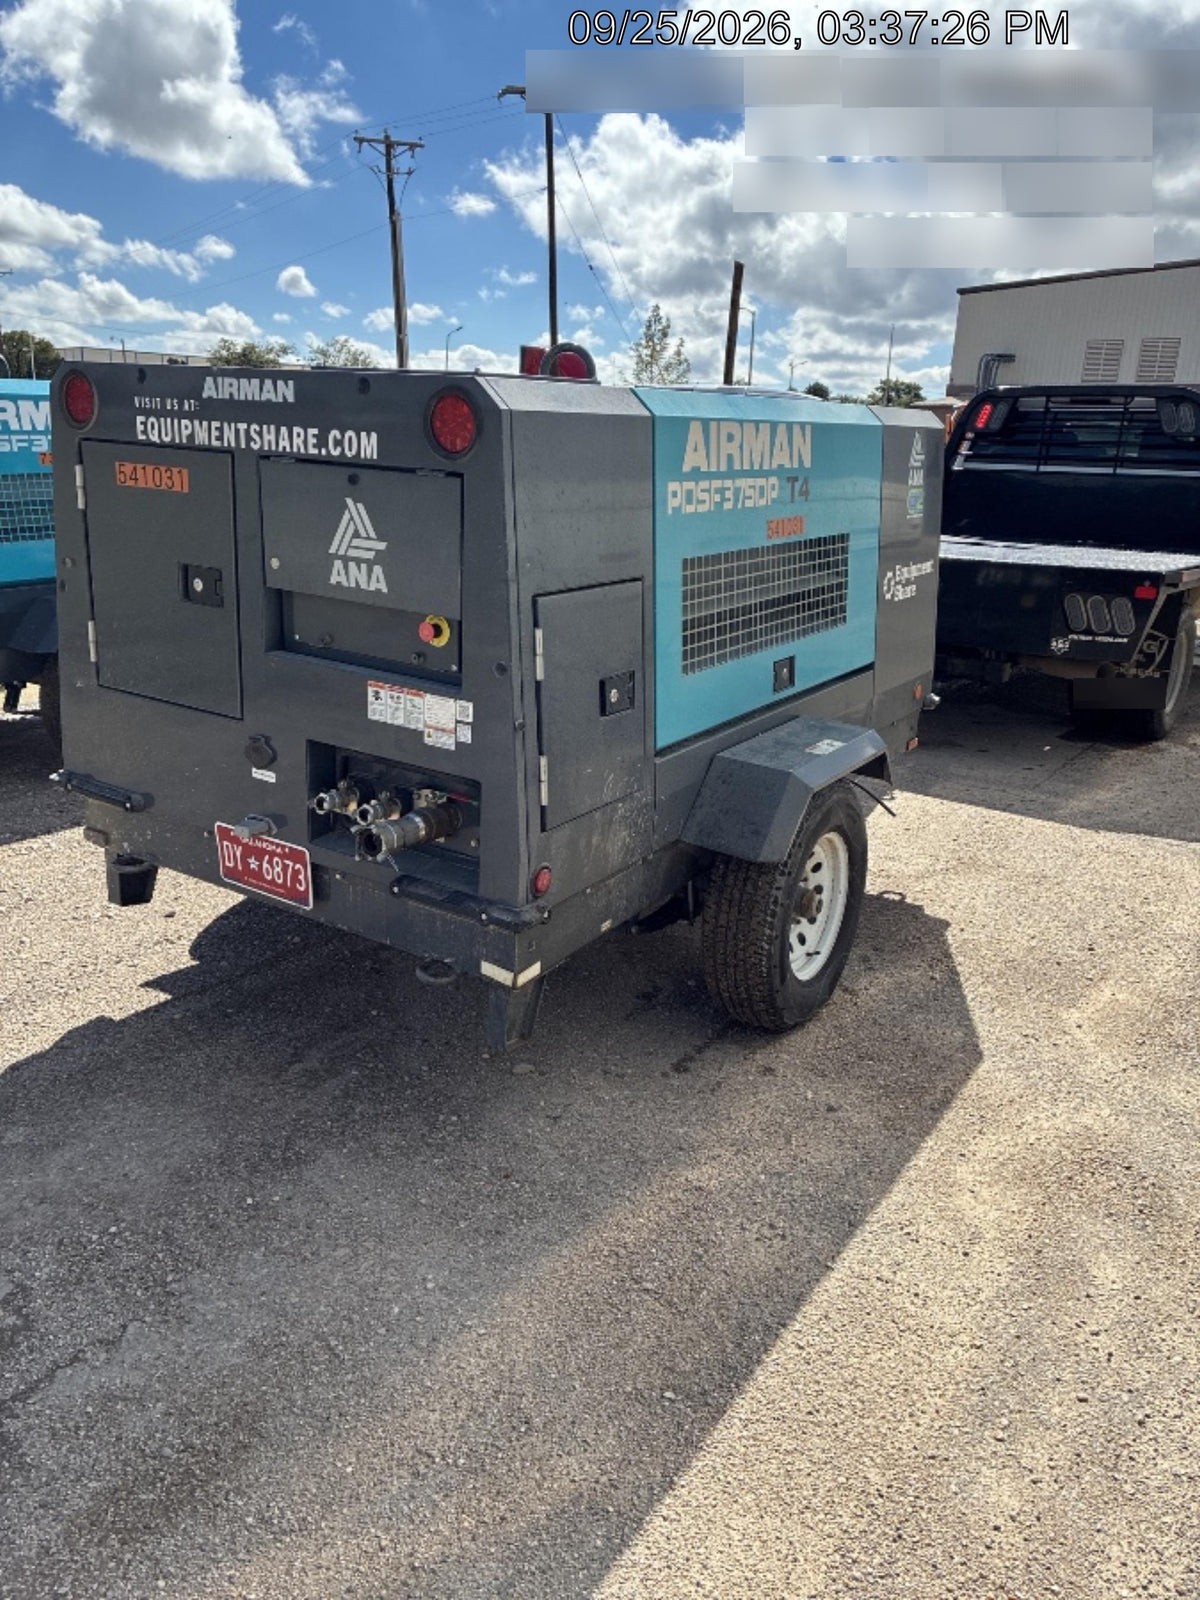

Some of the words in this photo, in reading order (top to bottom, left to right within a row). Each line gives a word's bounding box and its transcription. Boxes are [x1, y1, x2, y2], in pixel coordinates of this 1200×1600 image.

[134, 396, 160, 410] VISIT
[166, 397, 178, 410] US
[202, 376, 295, 403] AIRMAN
[136, 415, 378, 459] EQUIPMENTSHARE.COM
[682, 420, 812, 473] AIRMAN
[117, 463, 185, 491] 541031
[786, 475, 811, 503] T4
[329, 559, 388, 593] ANA
[223, 841, 242, 870] DY
[262, 855, 306, 891] 6873
